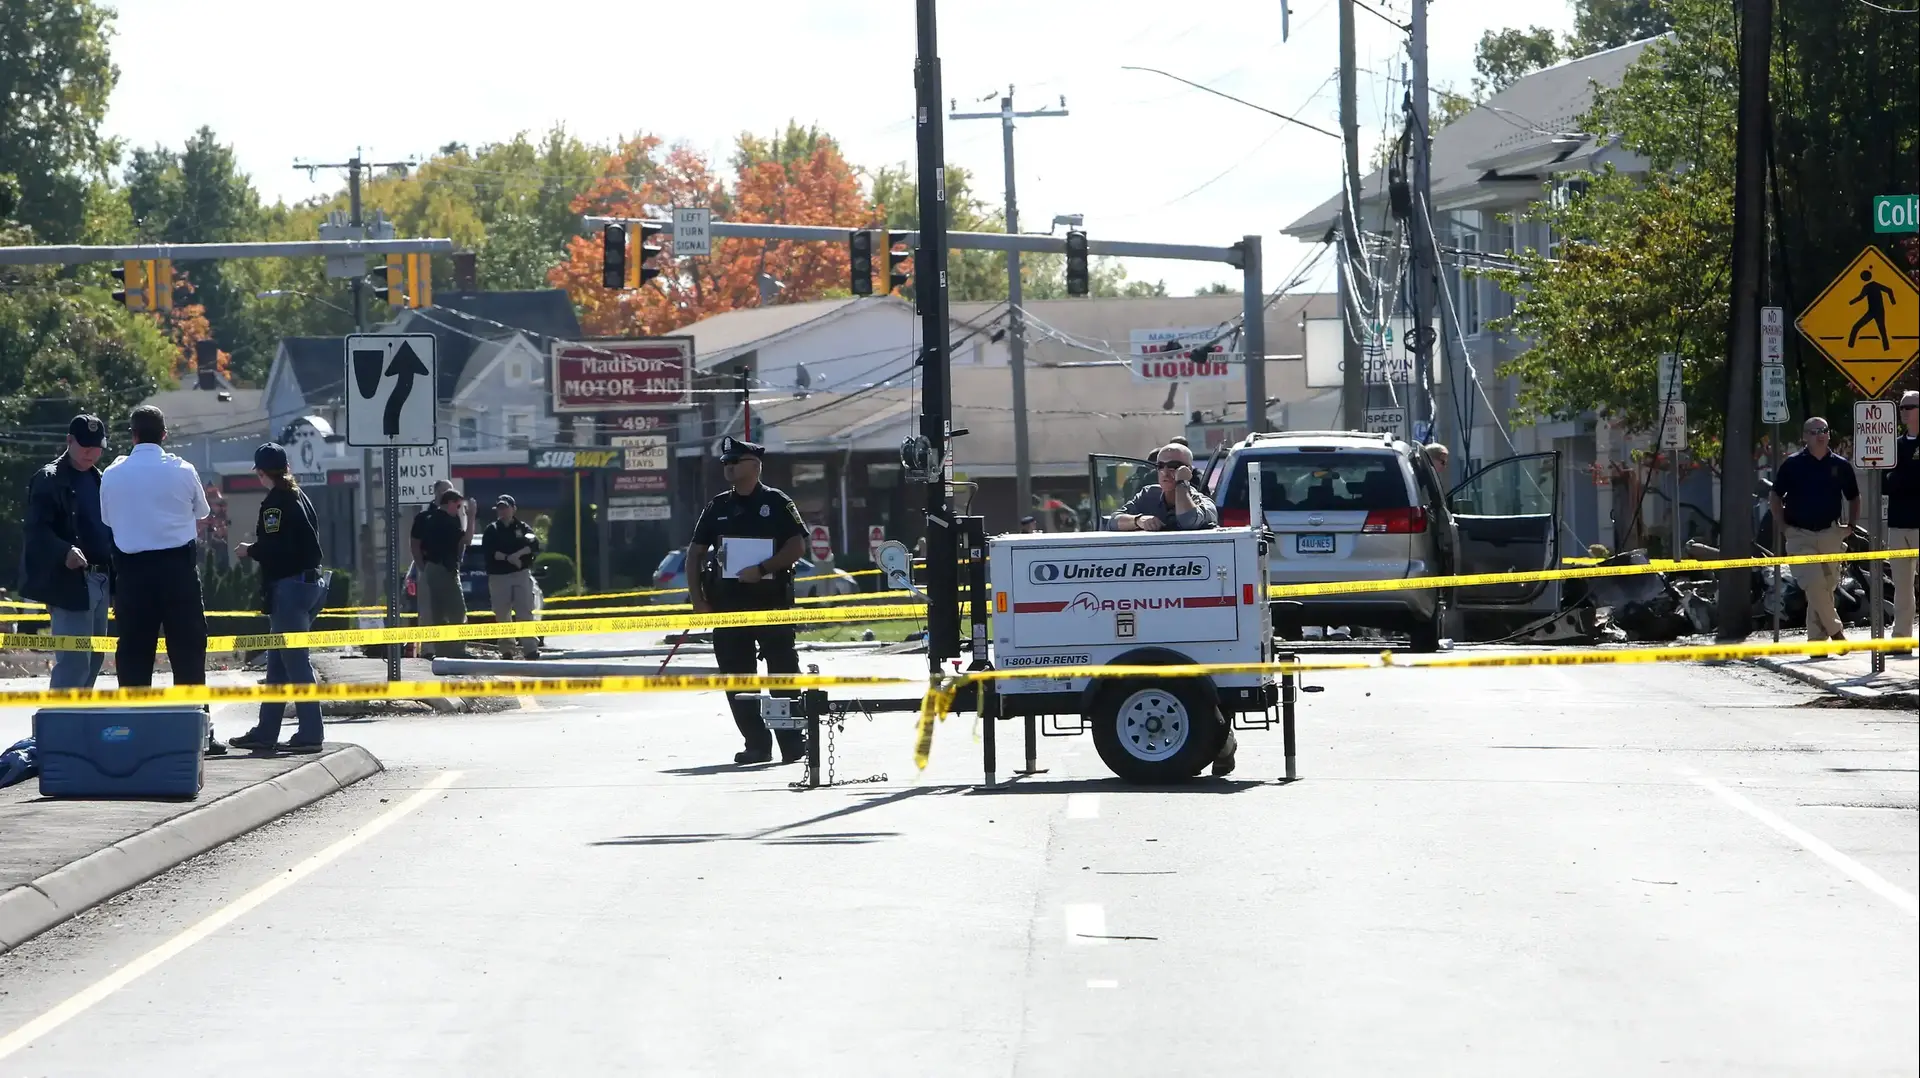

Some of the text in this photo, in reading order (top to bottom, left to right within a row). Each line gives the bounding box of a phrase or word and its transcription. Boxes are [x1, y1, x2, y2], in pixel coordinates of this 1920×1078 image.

[681, 213, 702, 222] LEFT
[681, 227, 704, 236] TURN
[676, 240, 706, 250] SIGNAL
[1768, 313, 1777, 323] NO
[1762, 325, 1782, 336] PARKING
[582, 354, 663, 374] Madison
[1142, 361, 1229, 378] LIQUOR
[1338, 359, 1413, 372] GODWIN
[1365, 371, 1408, 383] LLEGE
[564, 377, 680, 397] MOTOR INN
[1367, 414, 1403, 424] SPEED
[1866, 407, 1882, 420] NO
[1372, 425, 1399, 434] LIMIT
[1857, 422, 1894, 435] PARKING
[1866, 436, 1883, 444] ANY
[397, 446, 444, 458] EFT LANE
[1865, 446, 1884, 455] TIME
[537, 451, 618, 468] SUBWAY
[400, 464, 435, 478] MUST
[398, 485, 433, 496] URN LE
[1064, 561, 1202, 579] United Rentals
[1066, 594, 1182, 612] MAGNUM
[11, 635, 20, 645] NOT
[21, 636, 28, 646] DO
[29, 636, 39, 646] LINE
[40, 637, 56, 647] POLICE
[233, 637, 246, 648] CROSS
[273, 636, 288, 647] POLICE
[1004, 655, 1089, 666] 1-800-UR-RENTS
